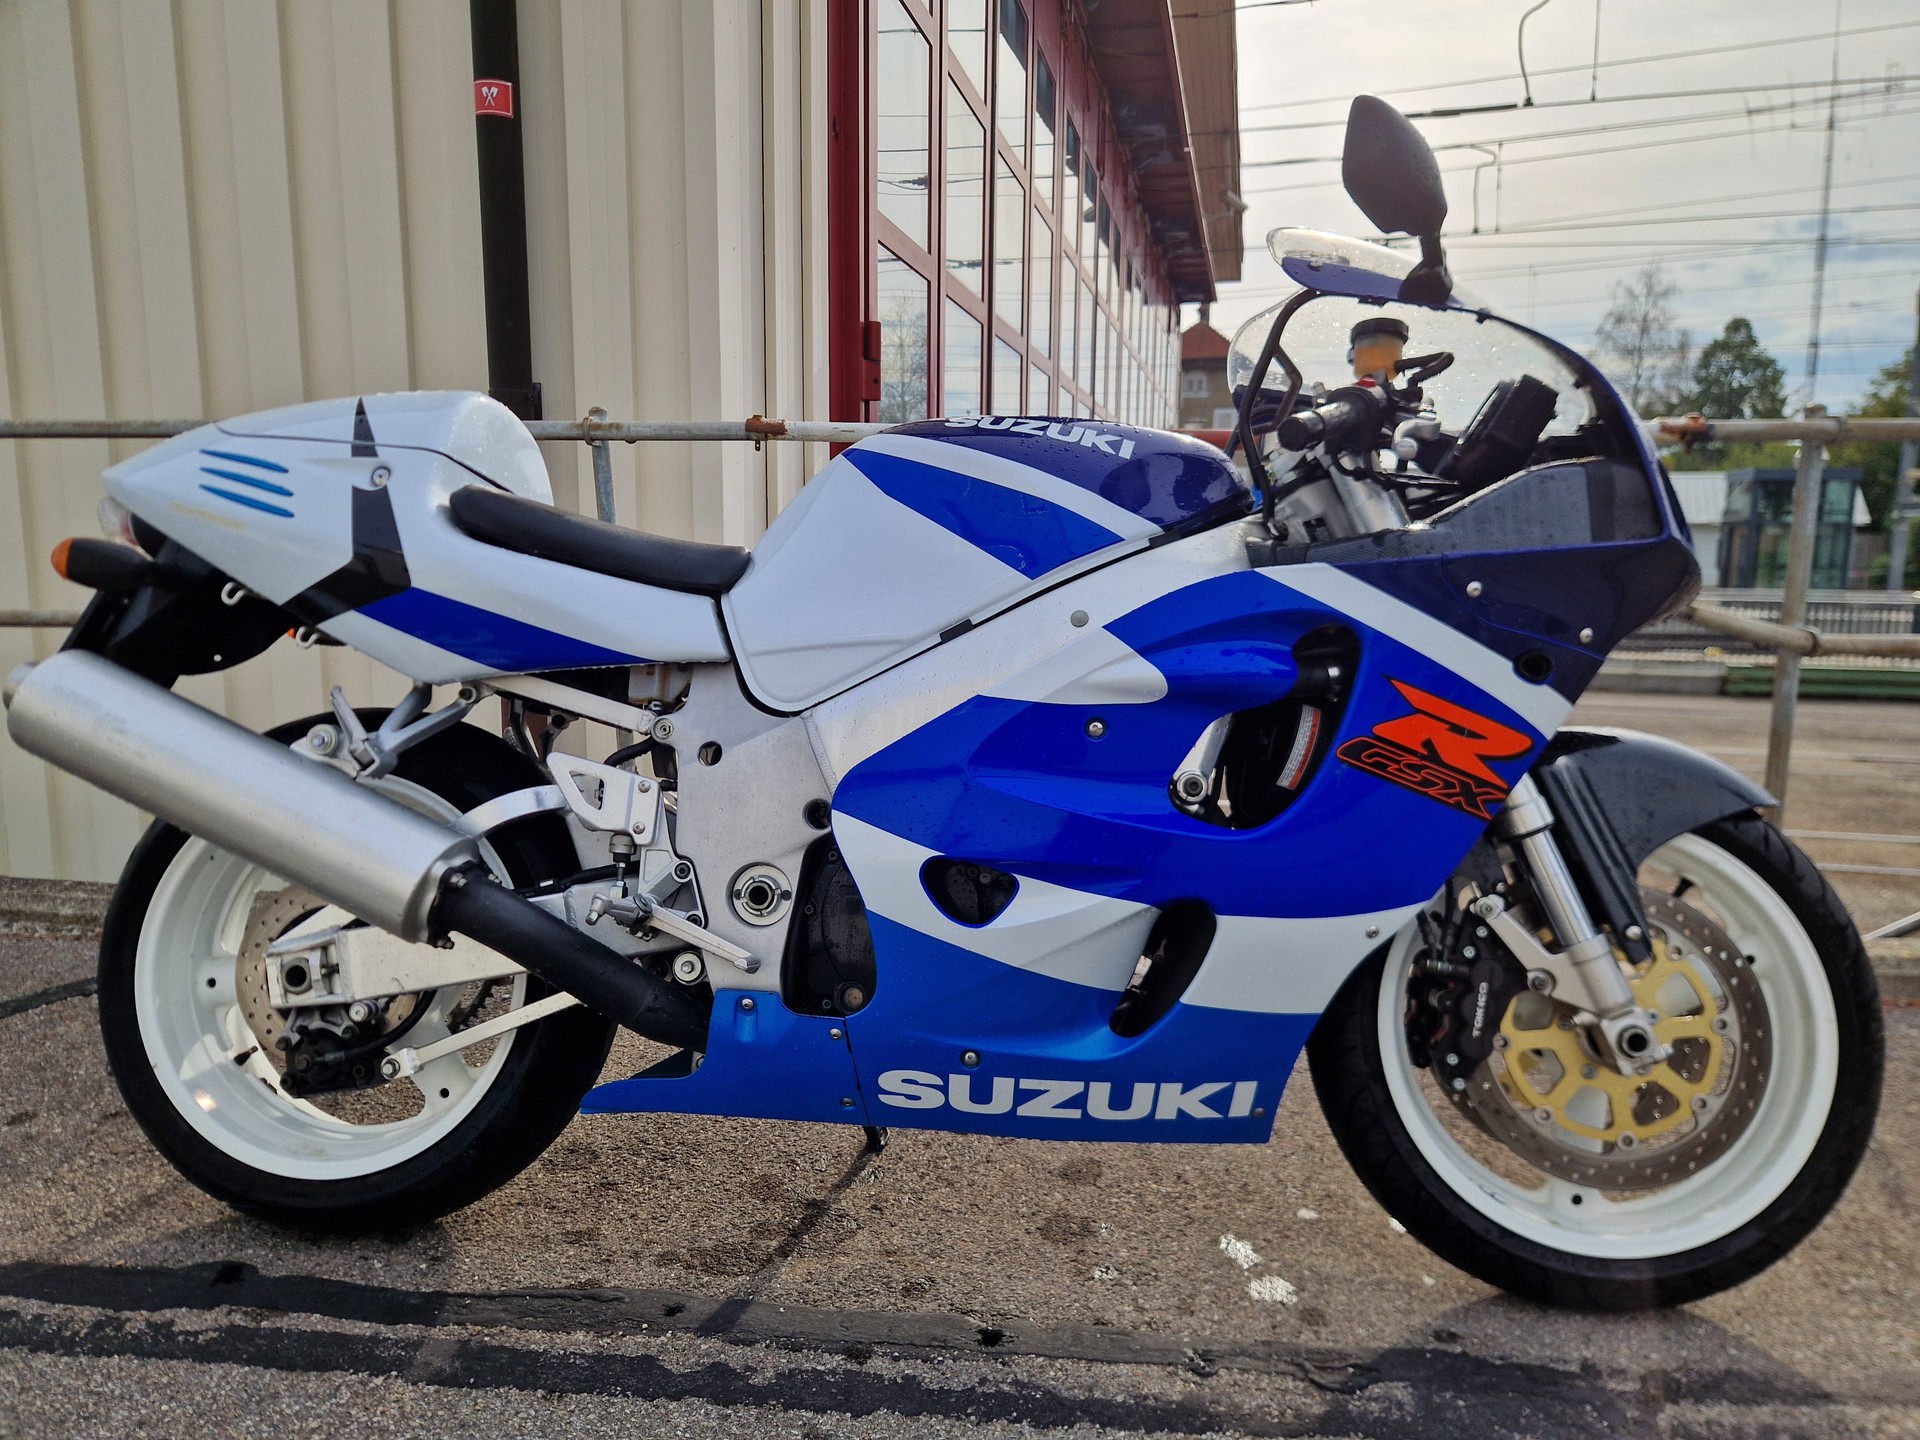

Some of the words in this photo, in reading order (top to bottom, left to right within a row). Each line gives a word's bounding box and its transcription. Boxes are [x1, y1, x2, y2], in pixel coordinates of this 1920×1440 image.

[944, 416, 1136, 461] SUZUKI
[1372, 677, 1533, 790] R
[1336, 736, 1508, 821] GSX
[877, 1069, 1258, 1120] SUZUKI
